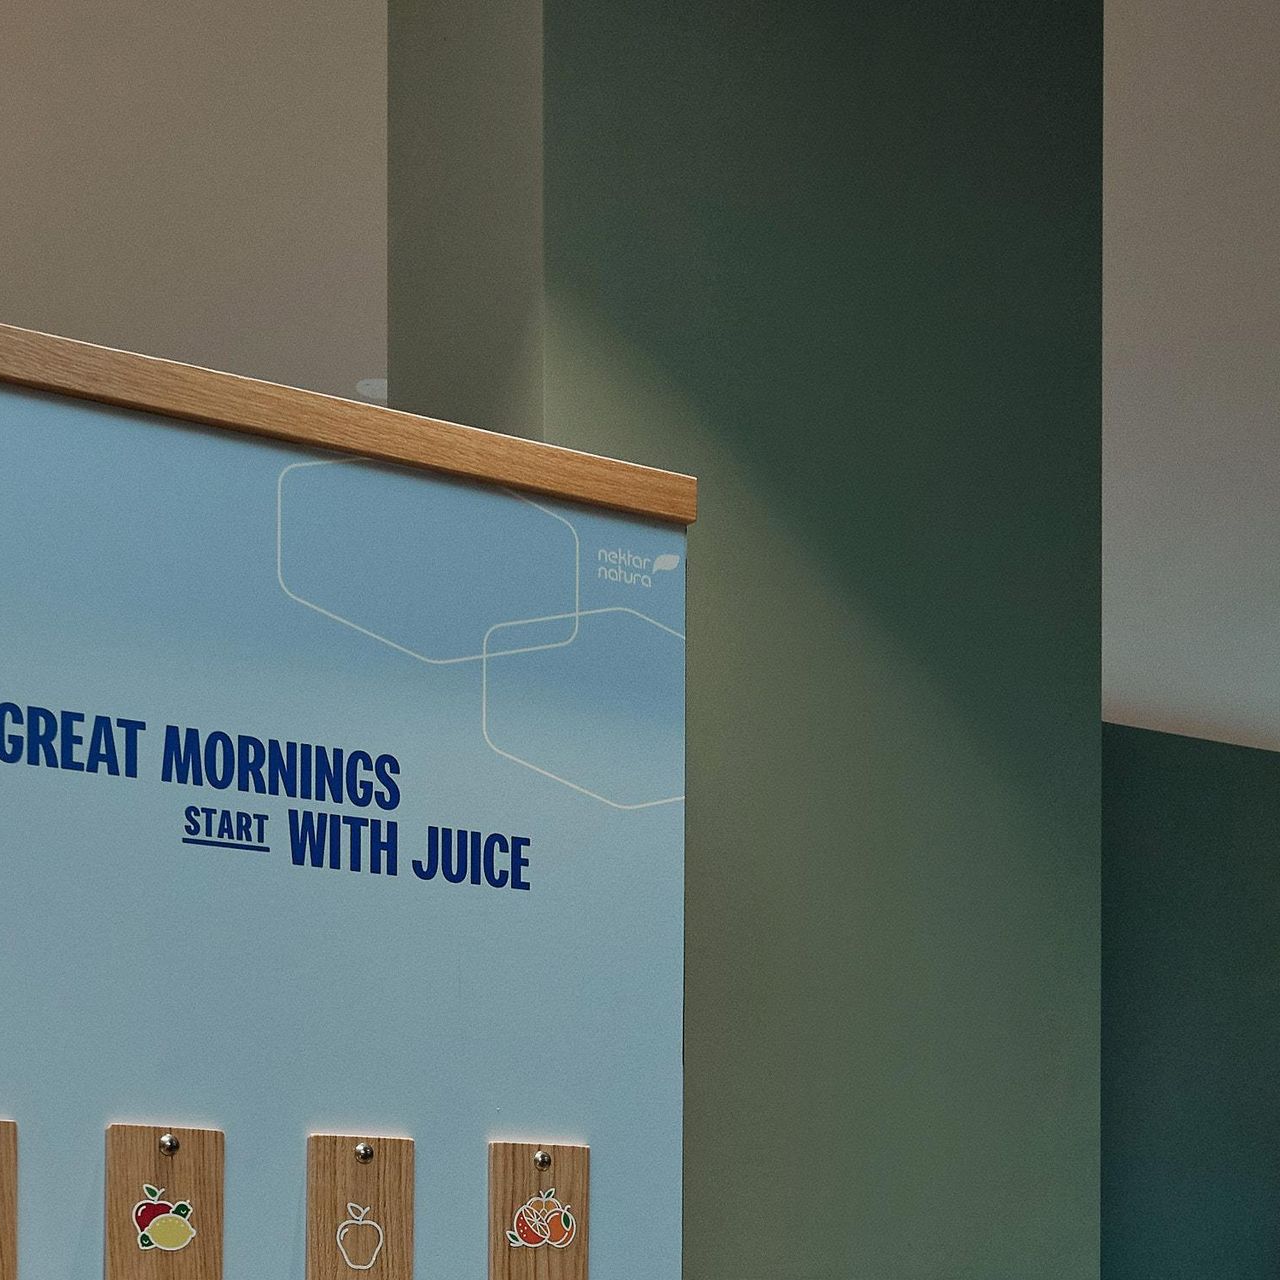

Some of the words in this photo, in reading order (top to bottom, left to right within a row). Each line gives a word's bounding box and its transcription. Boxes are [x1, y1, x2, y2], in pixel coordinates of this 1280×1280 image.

[597, 548, 651, 570] nektar
[597, 565, 652, 588] natura
[161, 724, 401, 811] MORNINGS
[183, 805, 269, 844] START
[288, 808, 398, 877] WITH
[411, 825, 532, 892] JUICE
